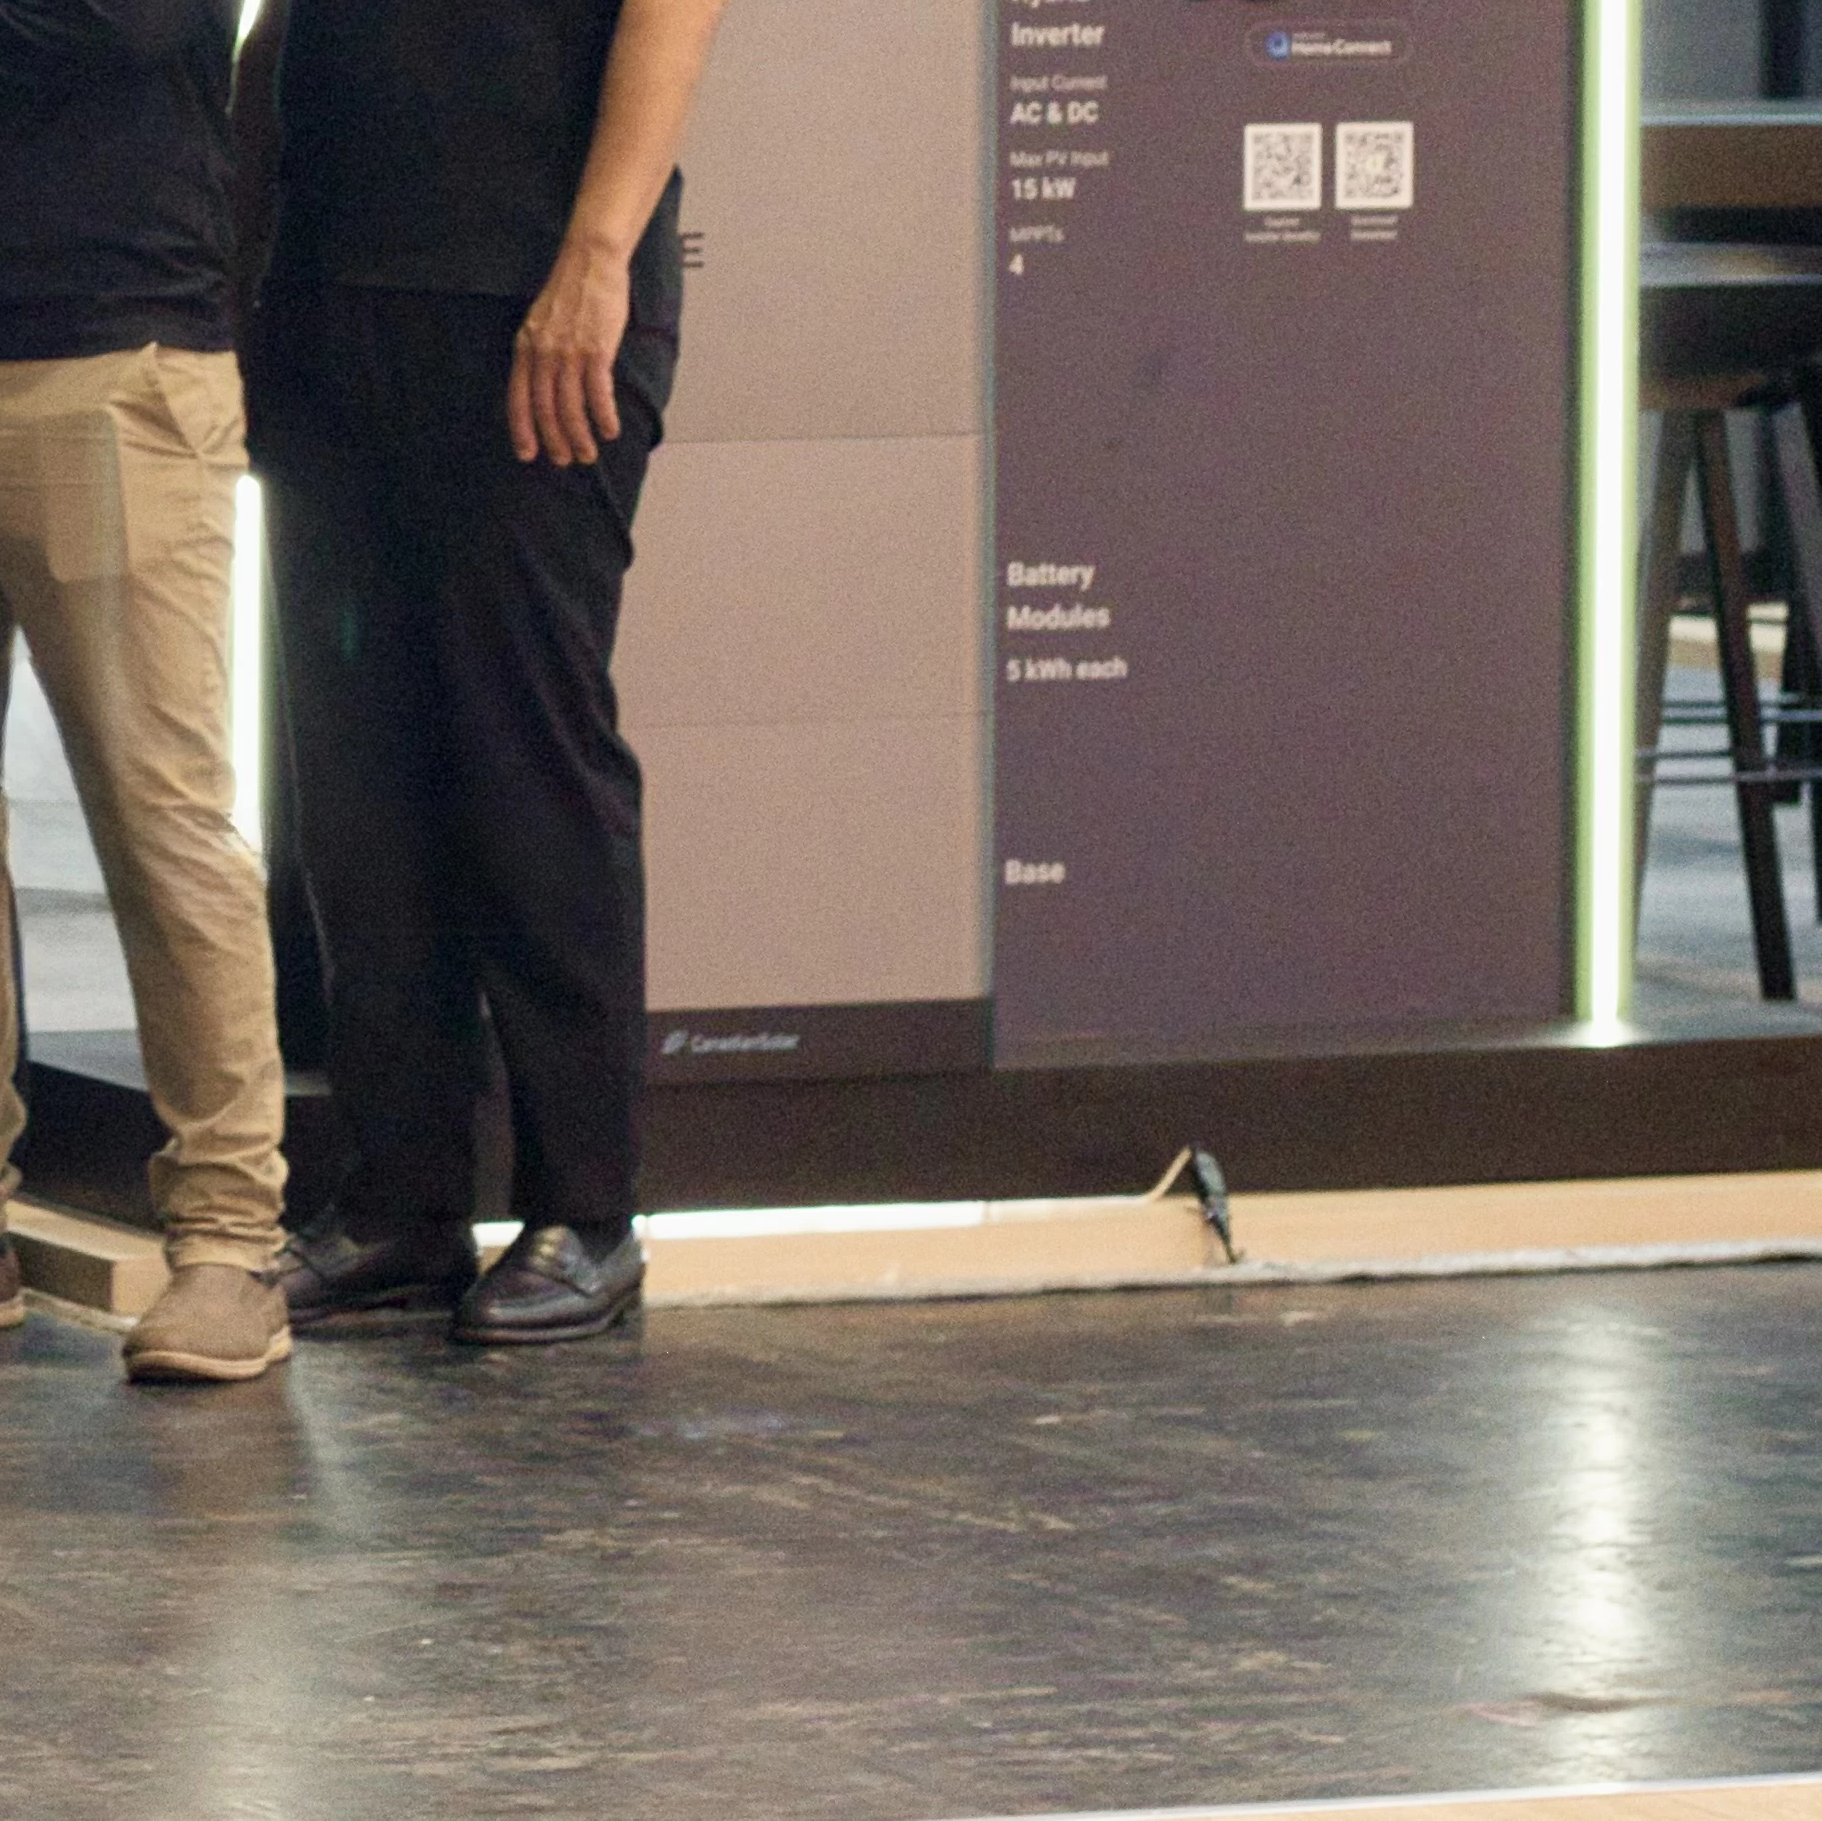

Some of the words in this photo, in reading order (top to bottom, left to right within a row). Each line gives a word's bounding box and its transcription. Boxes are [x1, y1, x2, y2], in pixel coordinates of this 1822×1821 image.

[1010, 21, 1106, 48] Inverter
[1009, 100, 1044, 125] AC
[1066, 100, 1100, 125] DC
[1011, 176, 1040, 201] 15
[1041, 176, 1077, 200] kW
[1007, 251, 1026, 276] 4
[1006, 560, 1096, 595] Battery
[1006, 602, 1112, 630] Modules
[1024, 655, 1073, 680] kWh
[1075, 654, 1129, 680] each
[1005, 858, 1068, 885] Base
